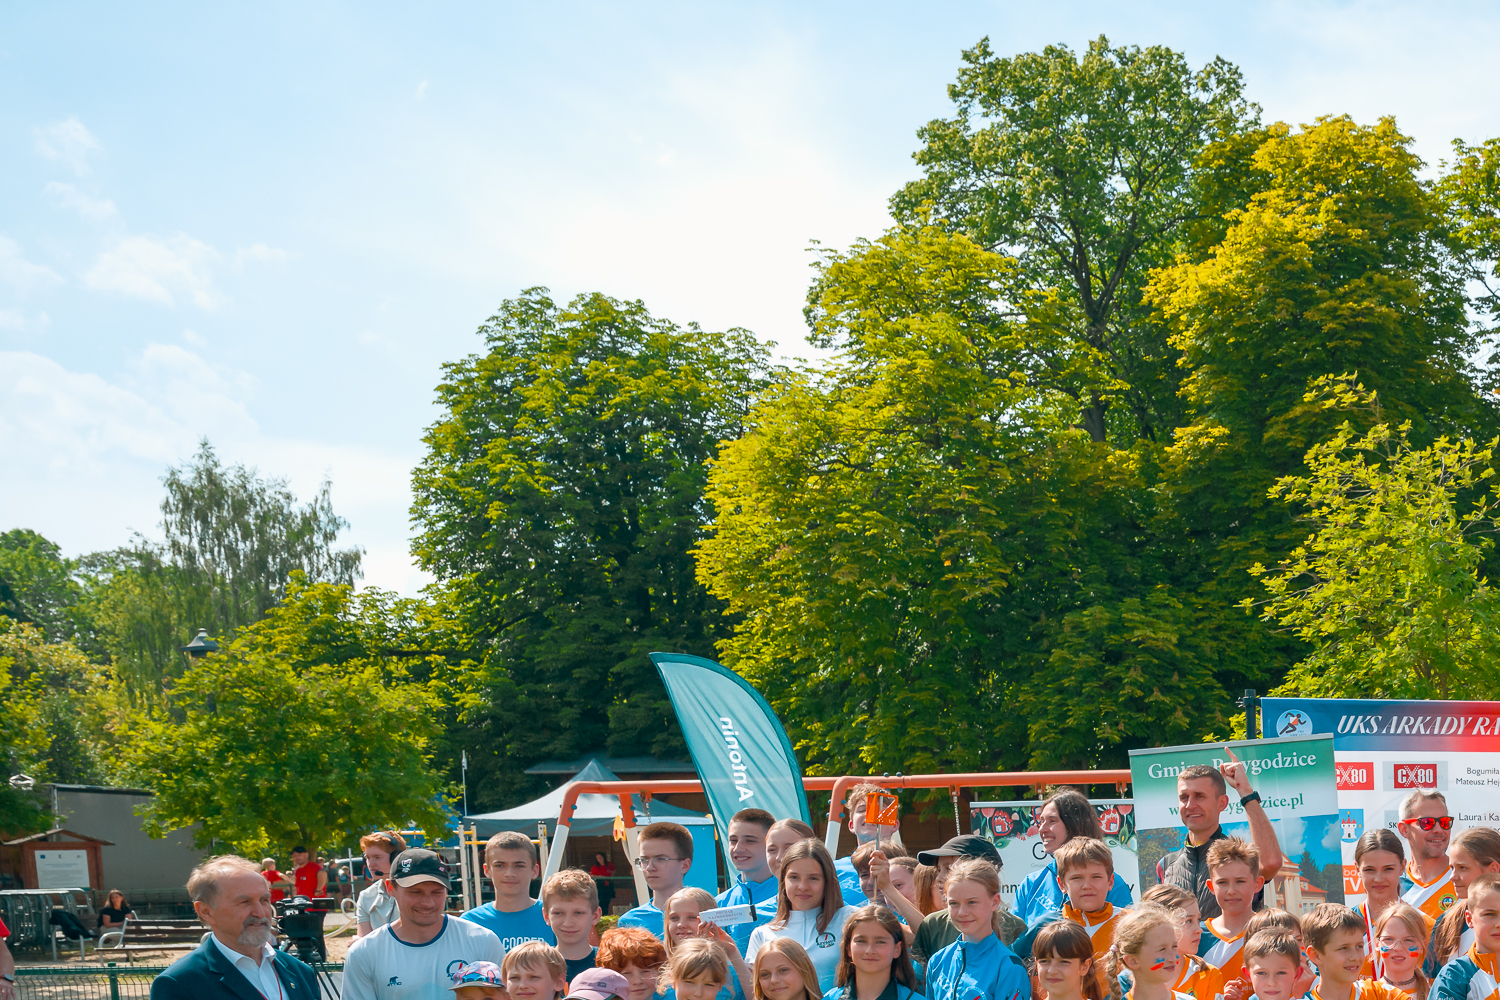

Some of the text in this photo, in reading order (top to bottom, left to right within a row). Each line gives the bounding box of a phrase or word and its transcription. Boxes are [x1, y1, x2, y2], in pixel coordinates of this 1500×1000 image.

[1337, 715, 1383, 735] UKS
[1382, 716, 1474, 735] ARKADY
[1212, 752, 1317, 776] Pygodzice
[1397, 765, 1434, 787] CX80
[1467, 767, 1500, 777] Bogumiła
[1456, 778, 1486, 786] Mateusz
[1458, 812, 1482, 822] Laura
